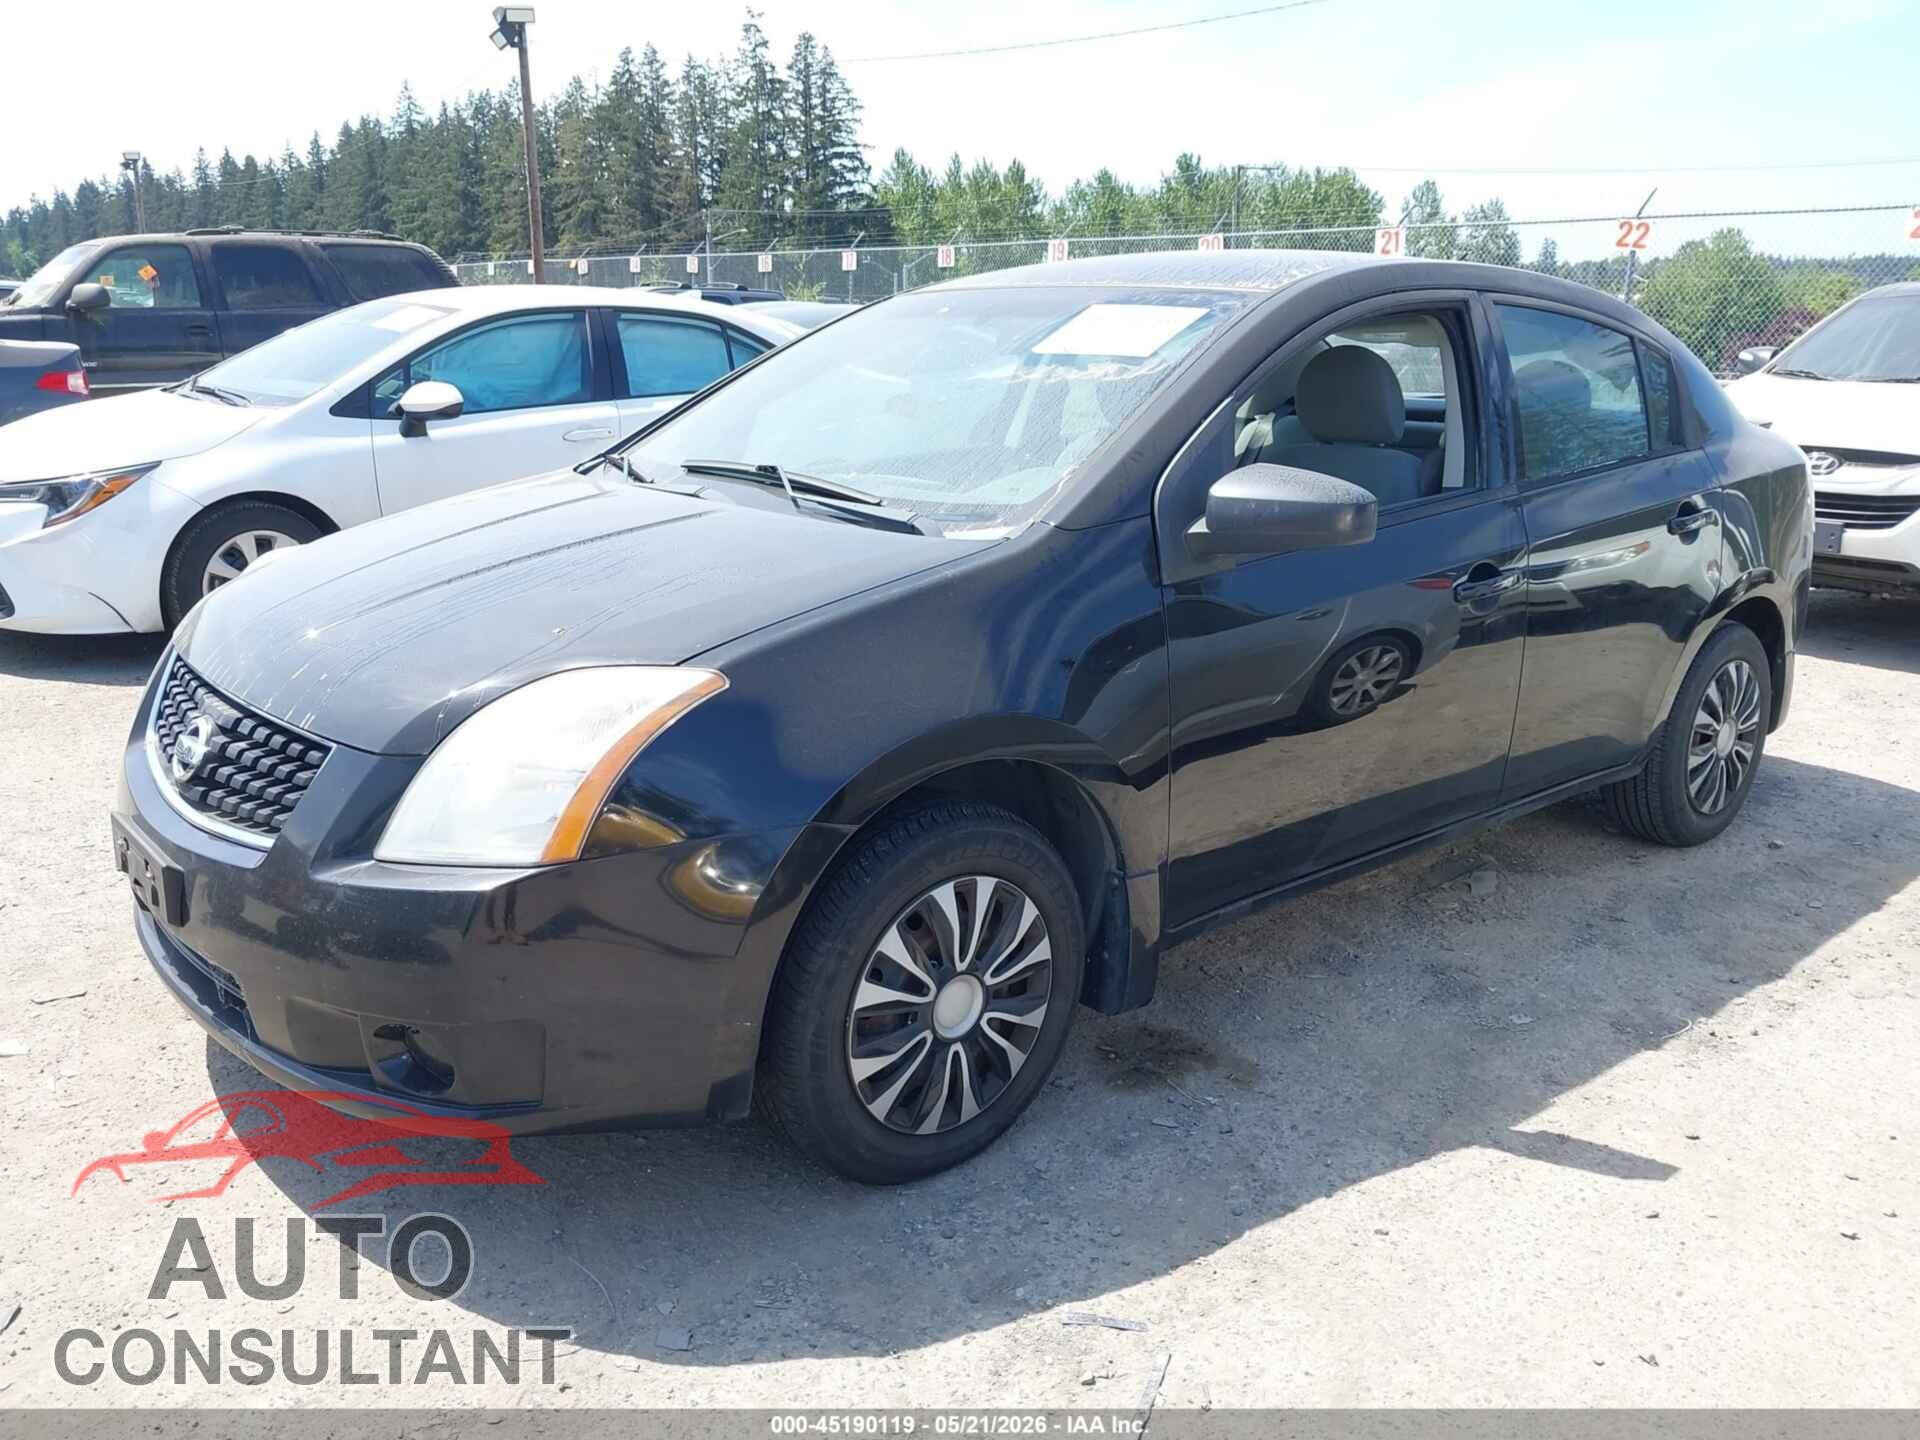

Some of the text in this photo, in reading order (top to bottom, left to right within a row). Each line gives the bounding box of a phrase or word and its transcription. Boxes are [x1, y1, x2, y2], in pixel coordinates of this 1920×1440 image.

[1381, 230, 1400, 255] 21
[1616, 221, 1650, 248] 22
[941, 248, 952, 266] 18
[1052, 240, 1066, 261] 19
